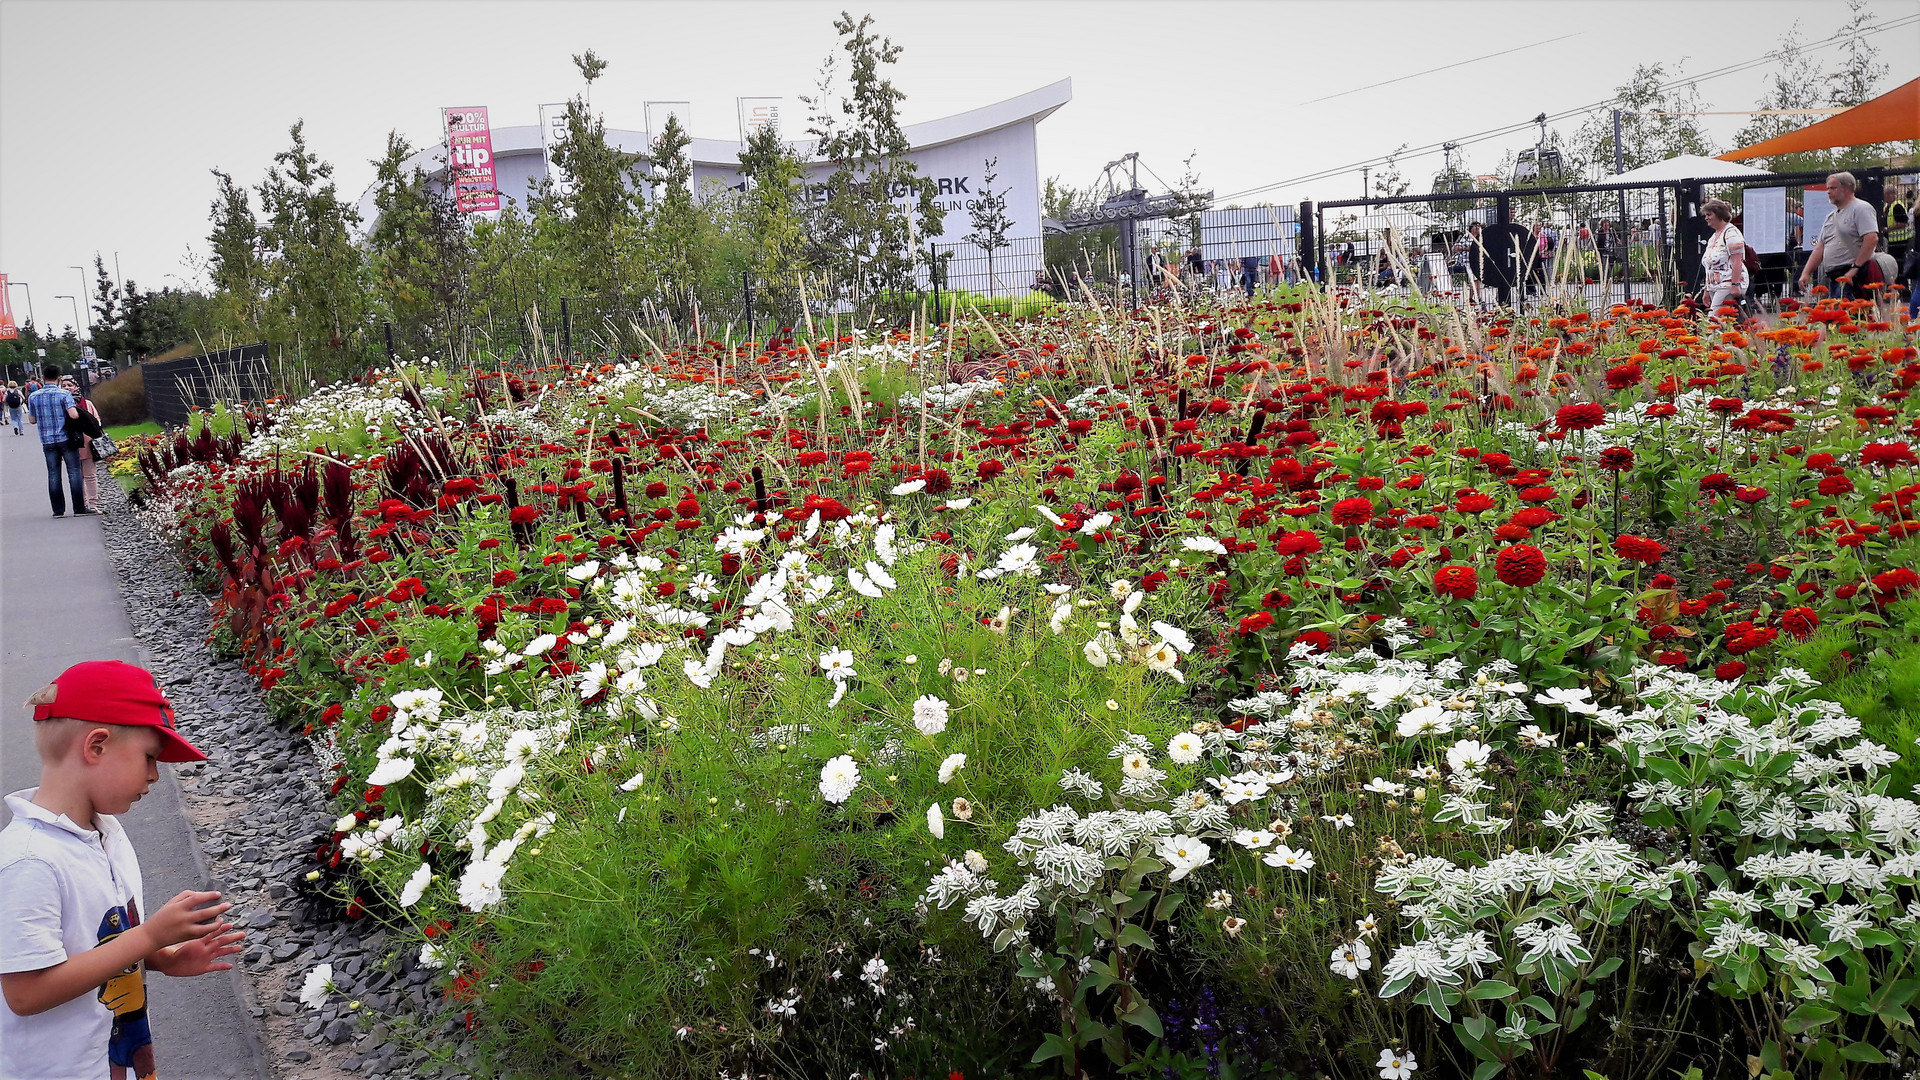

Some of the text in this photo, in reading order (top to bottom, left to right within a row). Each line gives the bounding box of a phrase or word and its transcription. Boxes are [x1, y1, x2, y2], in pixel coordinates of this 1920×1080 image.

[473, 135, 487, 143] MIT
[455, 143, 490, 168] tip
[457, 167, 492, 177] RLIN
[916, 200, 962, 213] BRLIN
